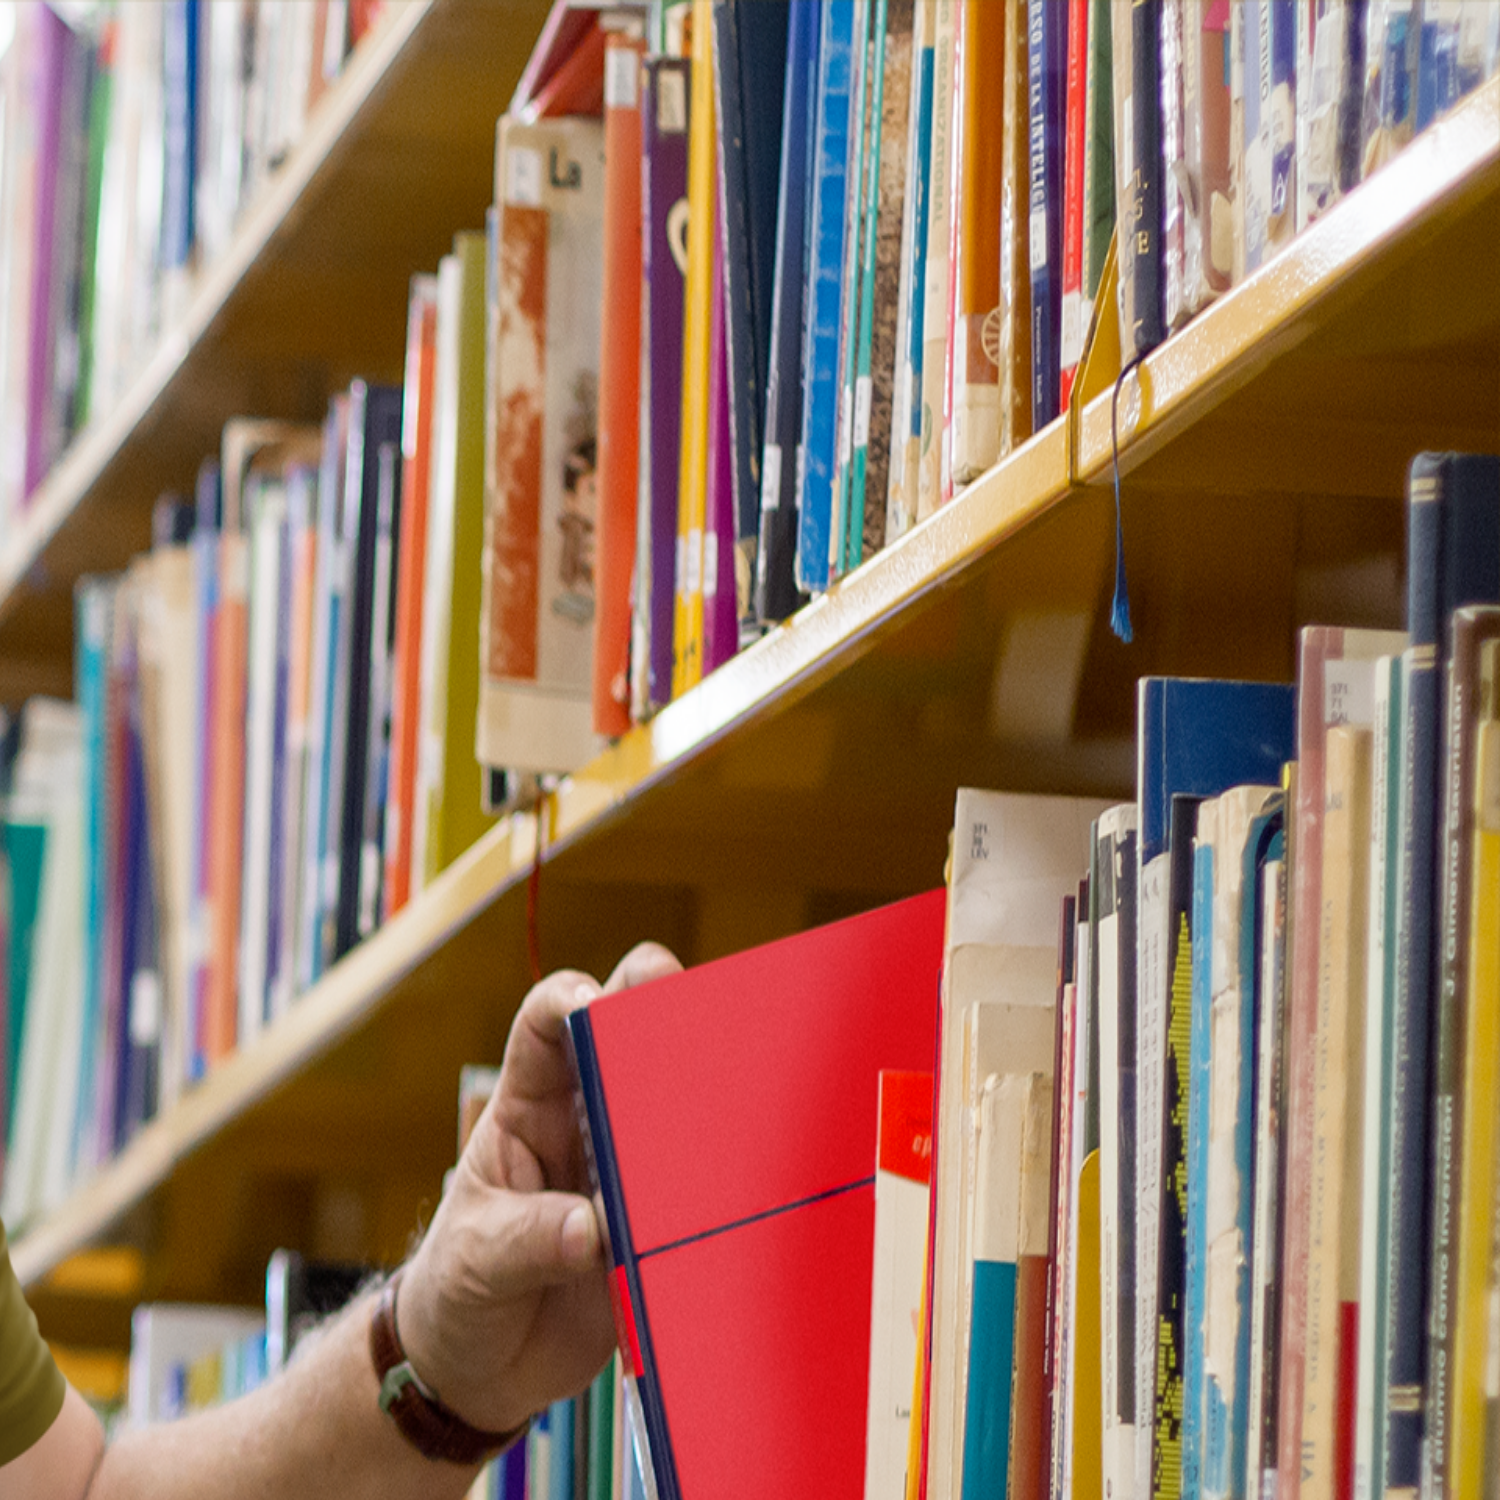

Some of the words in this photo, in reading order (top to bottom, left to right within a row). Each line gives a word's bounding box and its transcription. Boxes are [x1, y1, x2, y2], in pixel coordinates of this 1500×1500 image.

[1030, 0, 1043, 43] RSO
[933, 35, 949, 227] ORGANIZATIONAL
[1030, 82, 1041, 107] LA
[549, 146, 582, 190] La
[1447, 839, 1459, 962] Gimeno
[1319, 899, 1332, 1092] UNIVERSITARIA
[1314, 1136, 1327, 1247] ESCOLAR
[1309, 1262, 1322, 1382] MEDICINA
[1436, 1252, 1448, 1340] como
[1433, 1349, 1446, 1465] alumno
